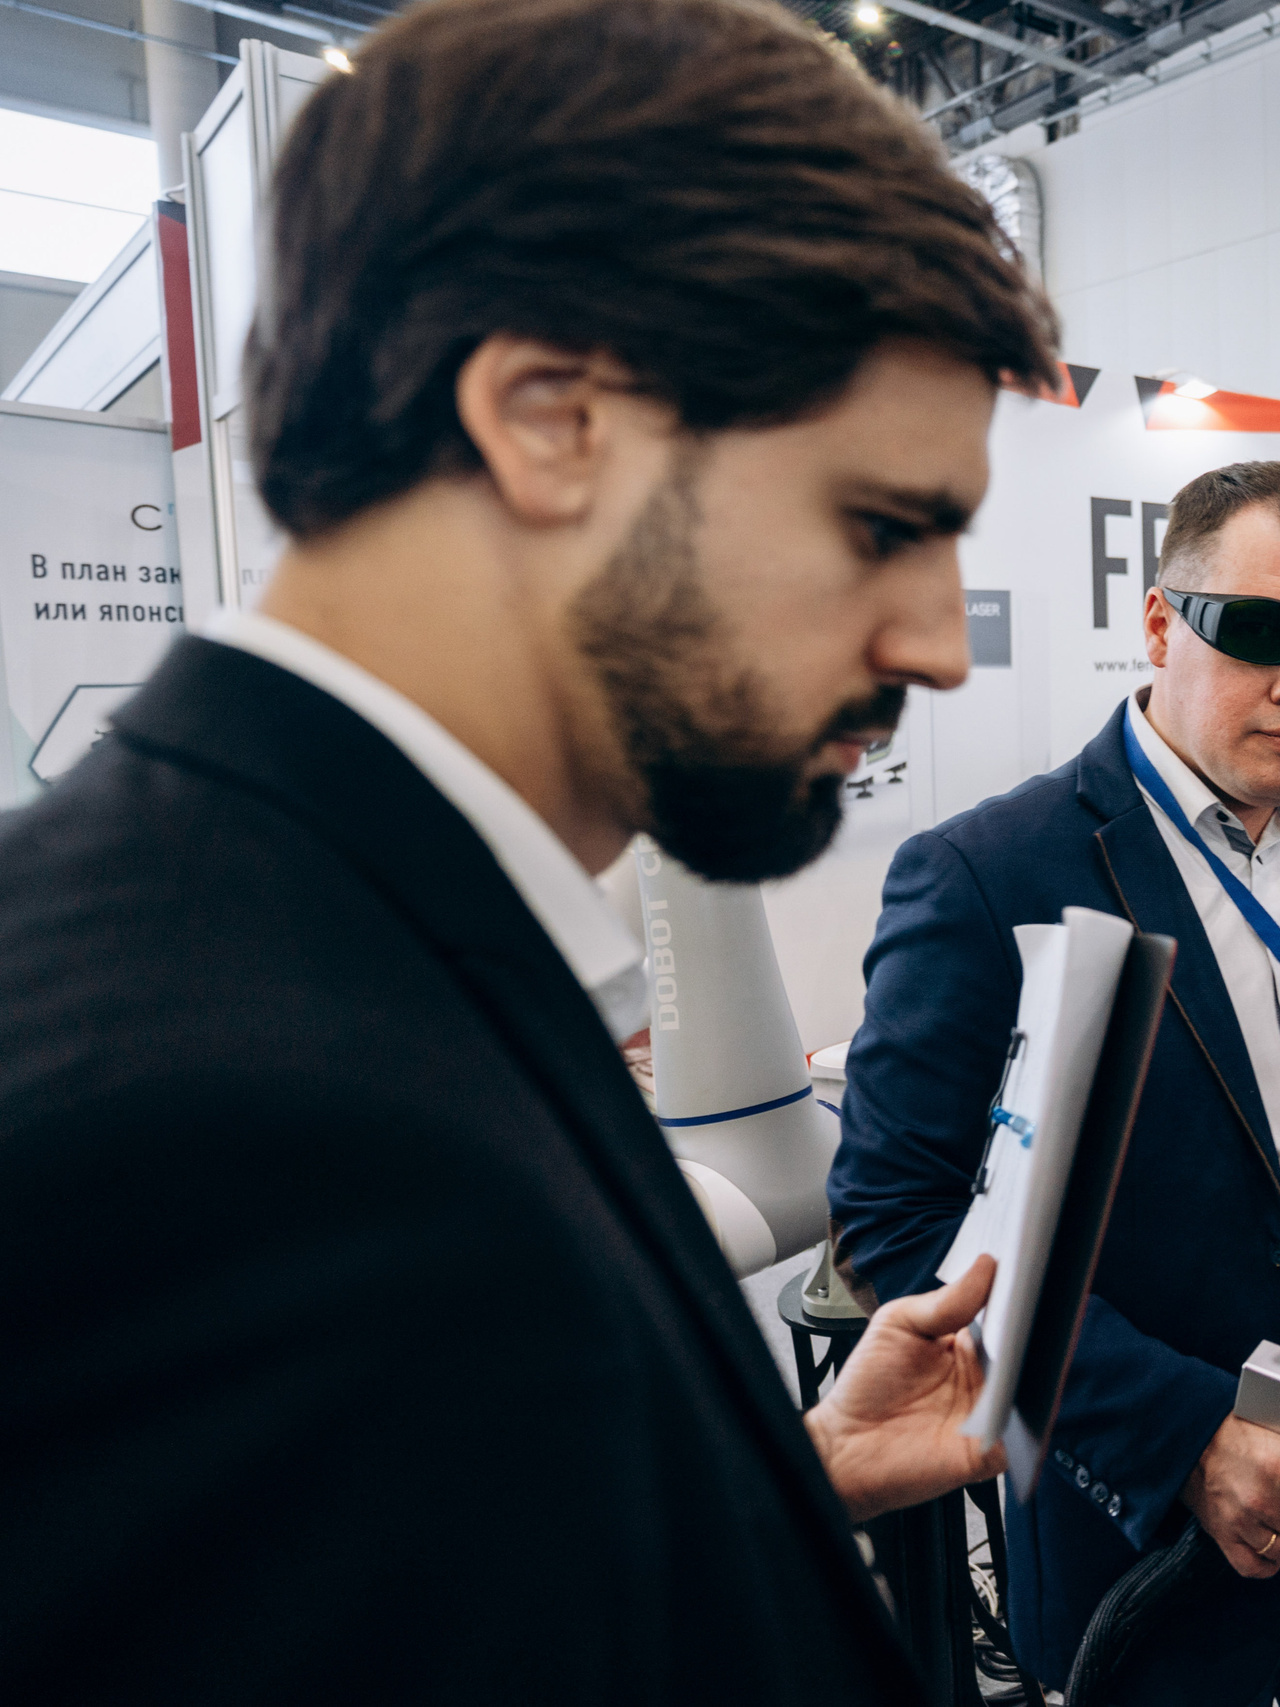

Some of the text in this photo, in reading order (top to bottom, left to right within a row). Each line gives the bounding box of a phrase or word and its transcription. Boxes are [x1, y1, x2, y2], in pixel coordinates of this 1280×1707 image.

[31, 553, 48, 579] В
[61, 561, 127, 583] план
[34, 602, 86, 620] или
[645, 893, 681, 1032] DOBOT
